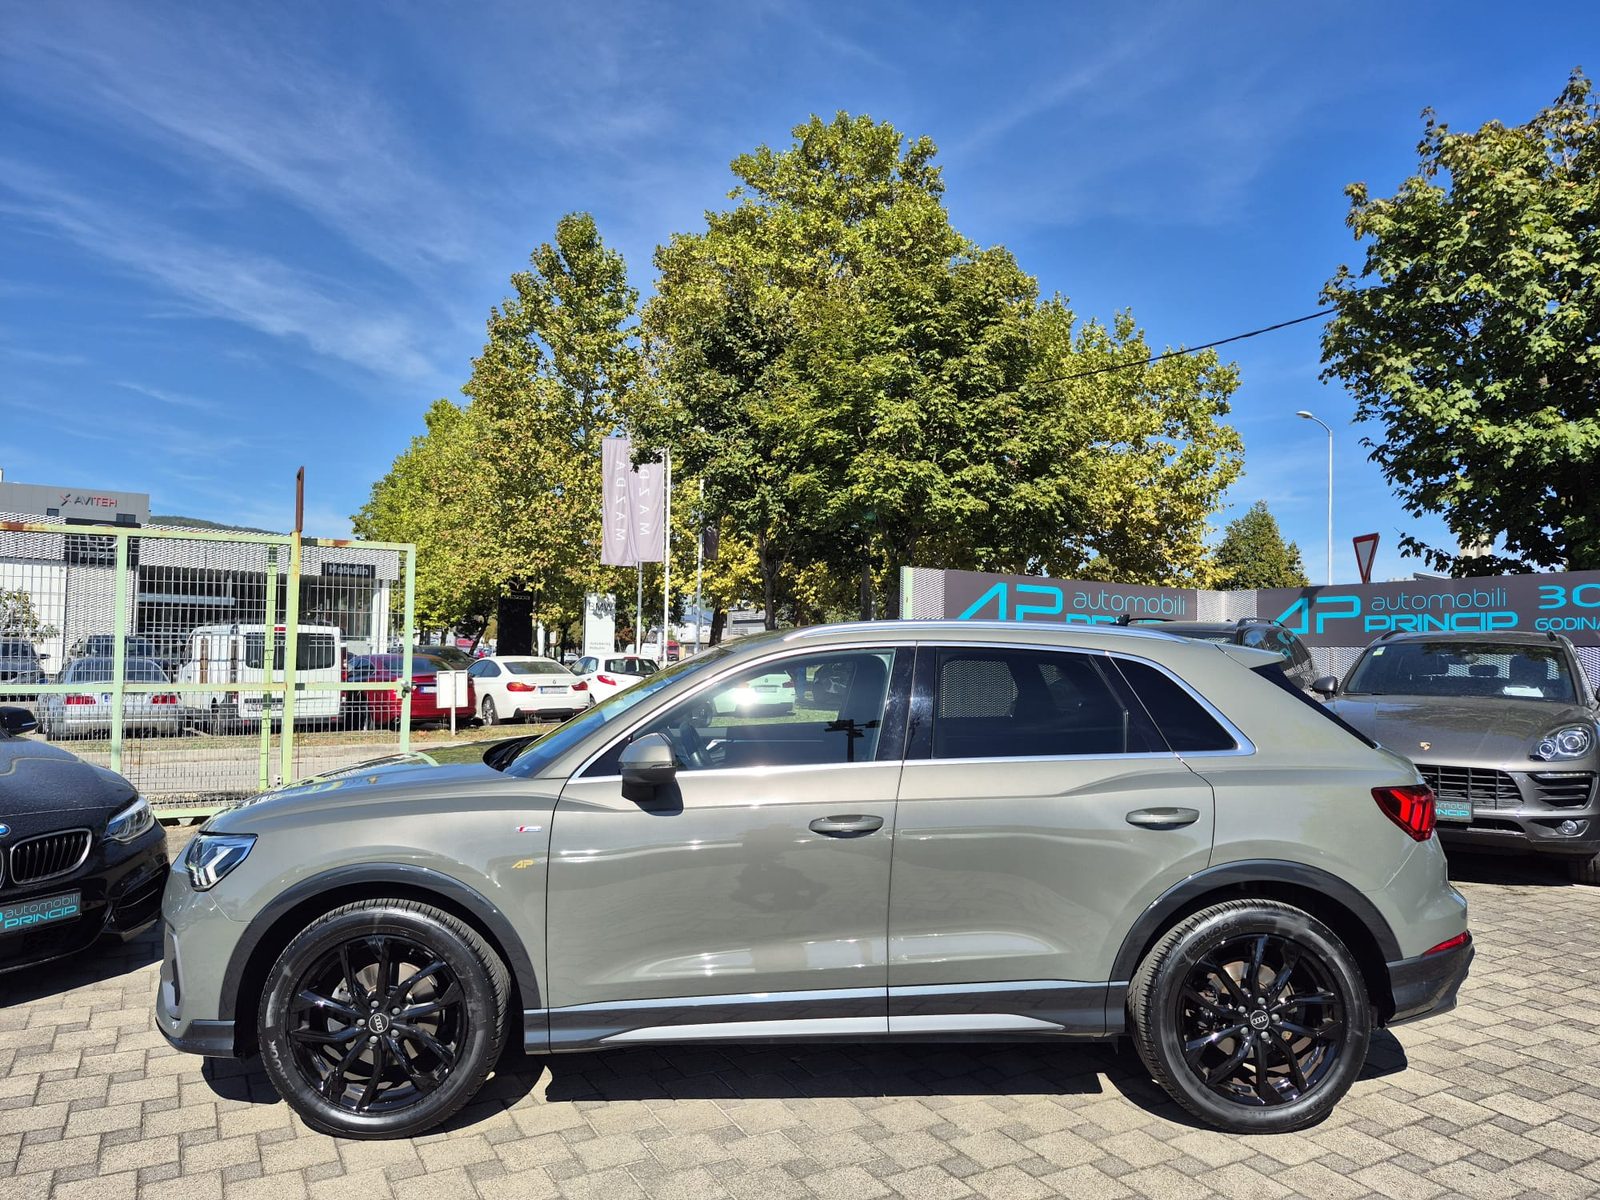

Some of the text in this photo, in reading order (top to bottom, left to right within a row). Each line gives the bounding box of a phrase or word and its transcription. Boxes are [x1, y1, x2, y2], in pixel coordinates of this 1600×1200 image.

[74, 496, 118, 508] AVITEH
[588, 602, 614, 612] BMW
[1072, 589, 1185, 616] automobili
[1370, 588, 1507, 611] automobili
[1364, 610, 1519, 633] PRINCIP
[1534, 616, 1600, 631] GODIN
[4, 893, 79, 918] automobili
[4, 904, 77, 929] PRINCIP
